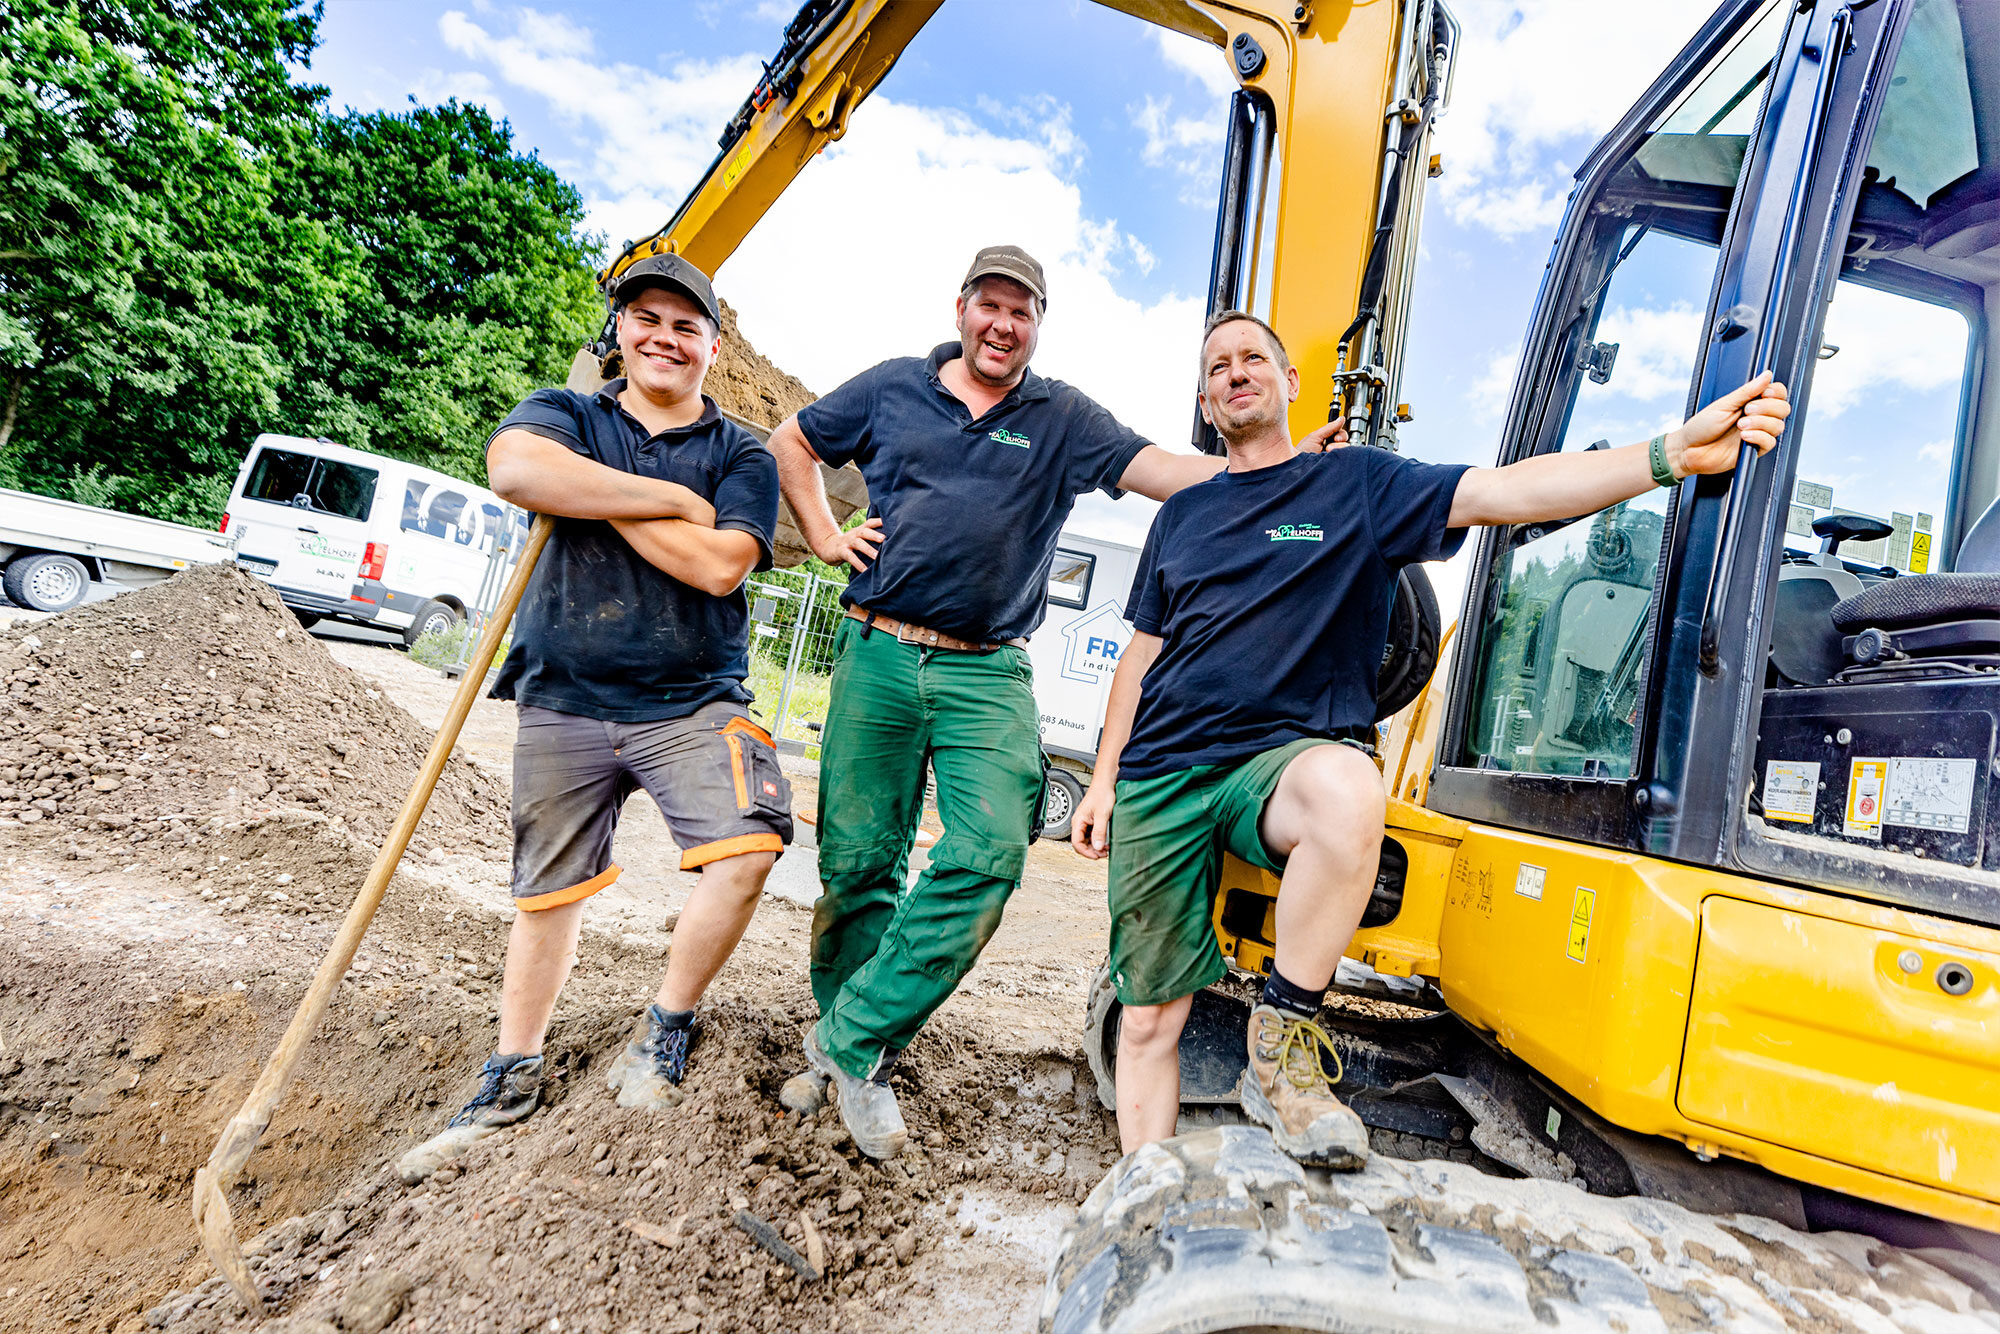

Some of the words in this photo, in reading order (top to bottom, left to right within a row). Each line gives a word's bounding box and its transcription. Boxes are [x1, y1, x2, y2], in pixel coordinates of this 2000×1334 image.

[315, 568, 346, 580] MAN
[1086, 636, 1125, 661] FR
[1058, 718, 1086, 731] Ahaus
